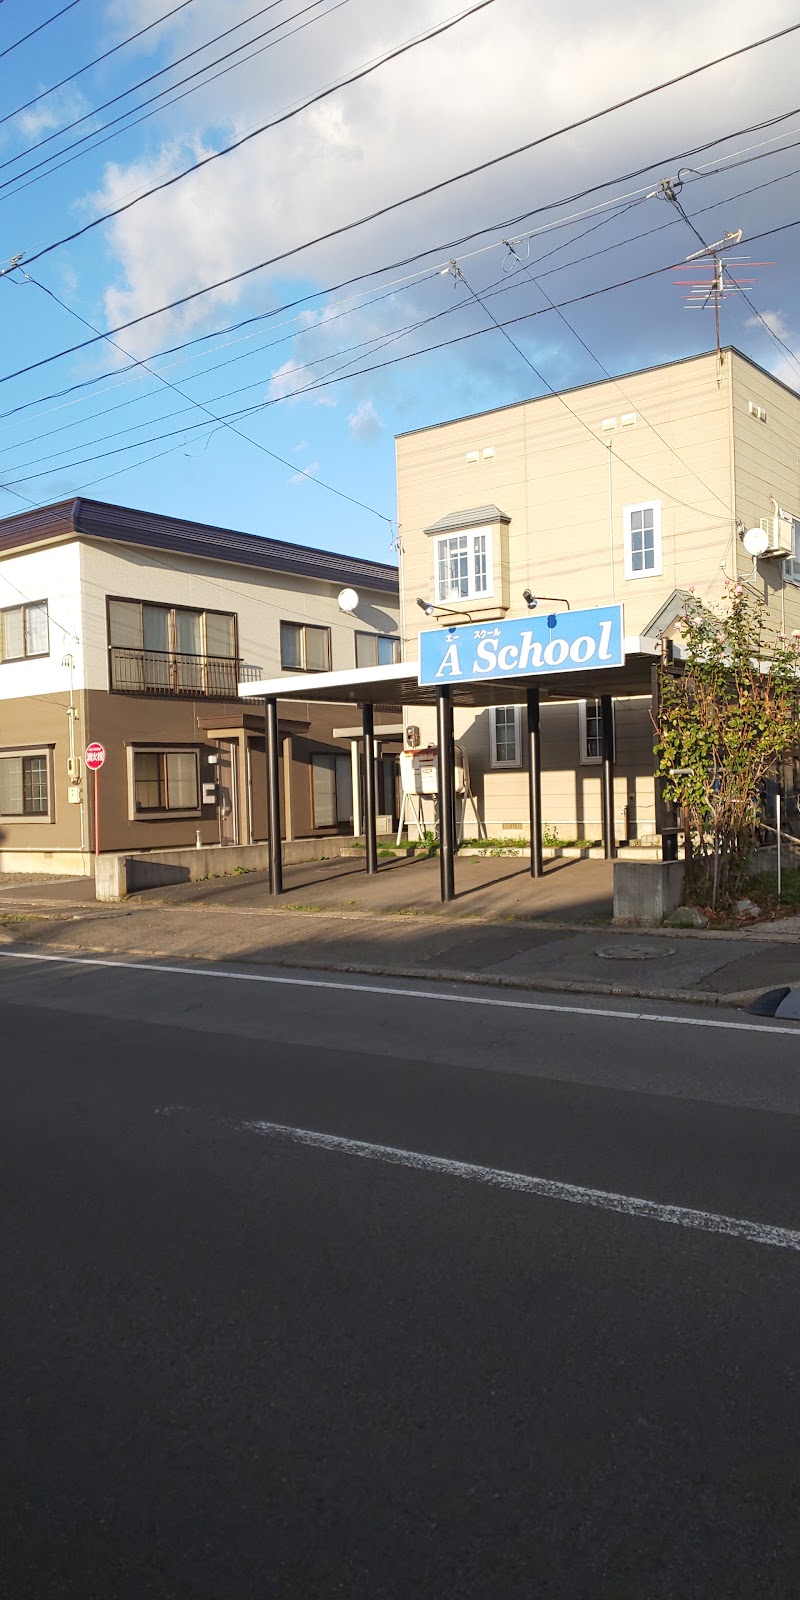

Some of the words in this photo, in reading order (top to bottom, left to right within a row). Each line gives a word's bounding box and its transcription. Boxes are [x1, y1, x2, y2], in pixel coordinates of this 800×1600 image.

[445, 634, 460, 643] エー
[473, 628, 502, 640] スクール
[434, 643, 463, 678] A
[472, 620, 613, 674] School
[86, 751, 104, 762] 消火栓
